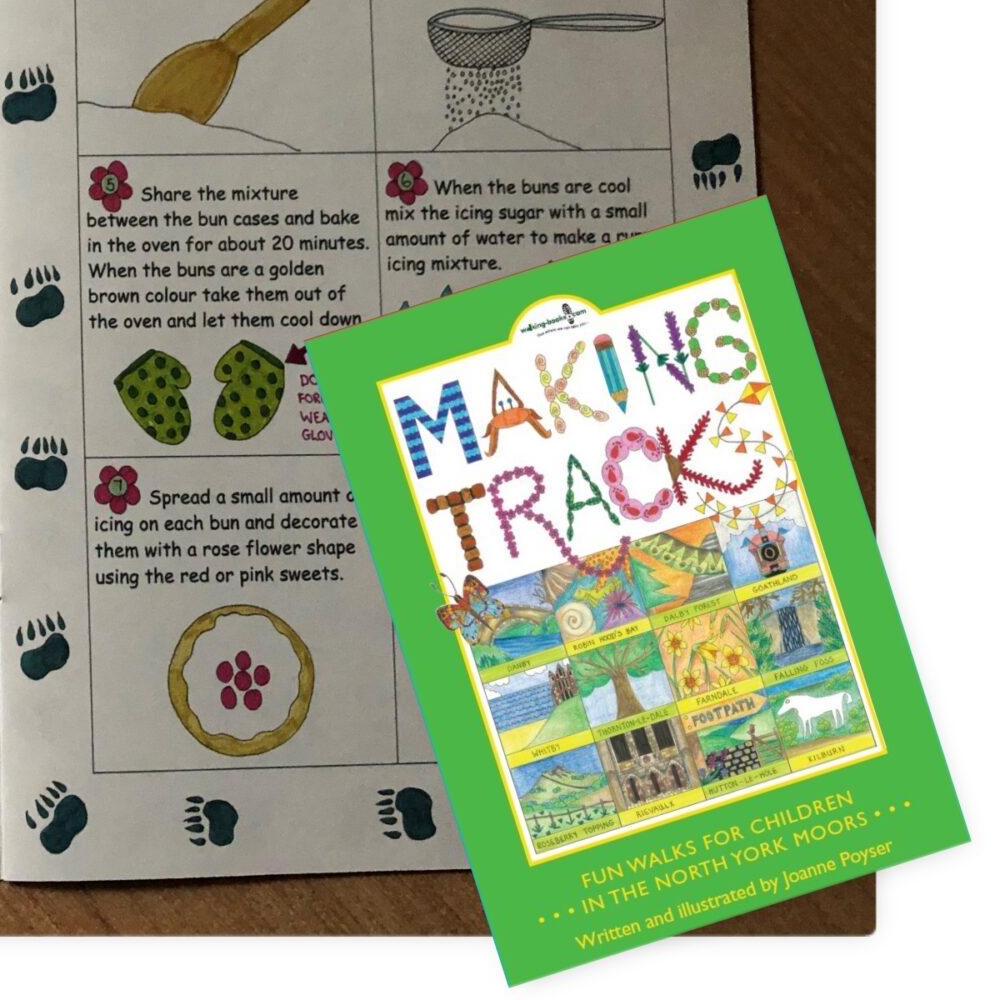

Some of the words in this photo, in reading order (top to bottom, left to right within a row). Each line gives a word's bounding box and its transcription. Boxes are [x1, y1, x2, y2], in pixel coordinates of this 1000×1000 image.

[106, 178, 115, 192] 5
[140, 185, 193, 203] Share
[196, 184, 227, 202] the
[231, 185, 299, 202] mixture
[401, 173, 411, 187] 6
[433, 178, 483, 196] When
[486, 178, 517, 195] the
[521, 178, 560, 195] buns
[564, 181, 594, 195] are
[597, 176, 631, 194] cool
[387, 255, 426, 277] icing
[430, 255, 503, 272] mixture.
[88, 287, 141, 304] brown
[144, 285, 198, 304] colour
[201, 285, 241, 303] take
[245, 285, 290, 303] them
[294, 286, 323, 302] out
[327, 283, 347, 302] of
[393, 298, 757, 480] MAKING
[113, 478, 122, 491] 7
[94, 540, 140, 559] them
[144, 540, 182, 558] with
[186, 544, 198, 558] a
[202, 543, 241, 558] rose
[245, 538, 302, 557] flower
[306, 537, 357, 560] shape
[752, 573, 798, 593] GOATHLAND
[663, 608, 690, 622] DALBY
[693, 598, 721, 613] FOREST
[625, 625, 639, 636] BAY
[507, 659, 531, 672] DANBY
[774, 664, 809, 681] FALLING
[814, 655, 834, 669] FOSS
[696, 686, 737, 706] FARNDALE
[691, 697, 756, 728] FOOTPATH
[531, 743, 561, 758] WHITBY
[808, 745, 846, 763] KILBURN
[583, 819, 615, 835] TOPPING
[580, 863, 624, 888] FUN
[626, 840, 697, 873] WALKS
[702, 825, 744, 850] FOR
[750, 790, 854, 835] CHILDREN
[581, 894, 606, 914] IN
[608, 880, 649, 905] THE
[654, 855, 728, 891] NORTH
[731, 836, 788, 866] YORK
[793, 811, 868, 847] MOORS
[575, 920, 642, 950] Written
[645, 907, 675, 929] and
[677, 881, 757, 919] illustrated
[759, 876, 779, 895] by
[782, 858, 837, 891] Joanne
[839, 840, 893, 867] Poyser
